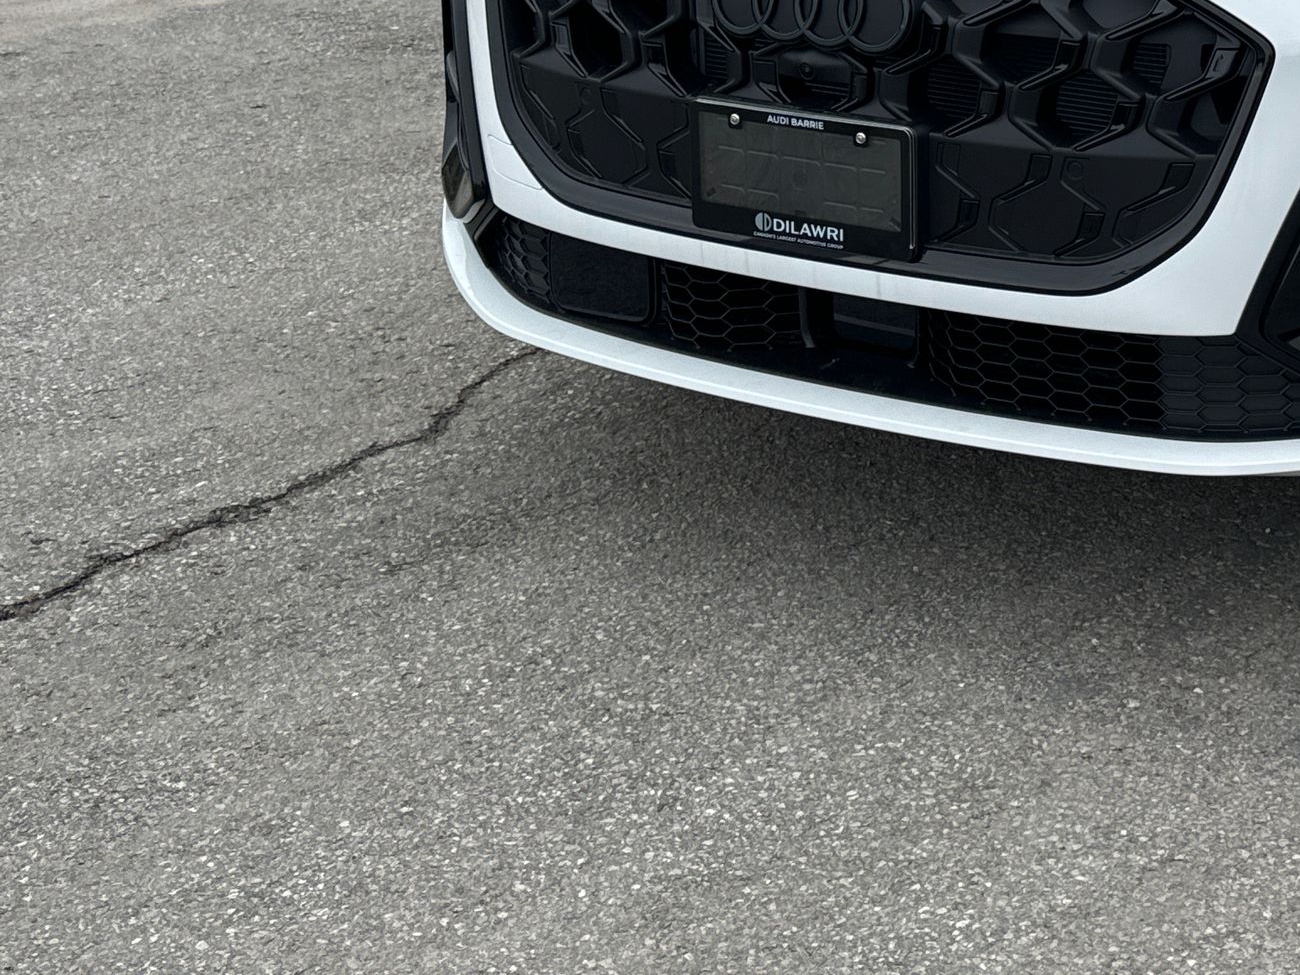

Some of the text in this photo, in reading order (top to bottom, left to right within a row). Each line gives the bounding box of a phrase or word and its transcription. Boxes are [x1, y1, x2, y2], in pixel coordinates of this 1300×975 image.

[767, 115, 824, 130] AUDI BARRIE
[773, 218, 844, 241] DILAWRI
[776, 234, 796, 242] LARGEST
